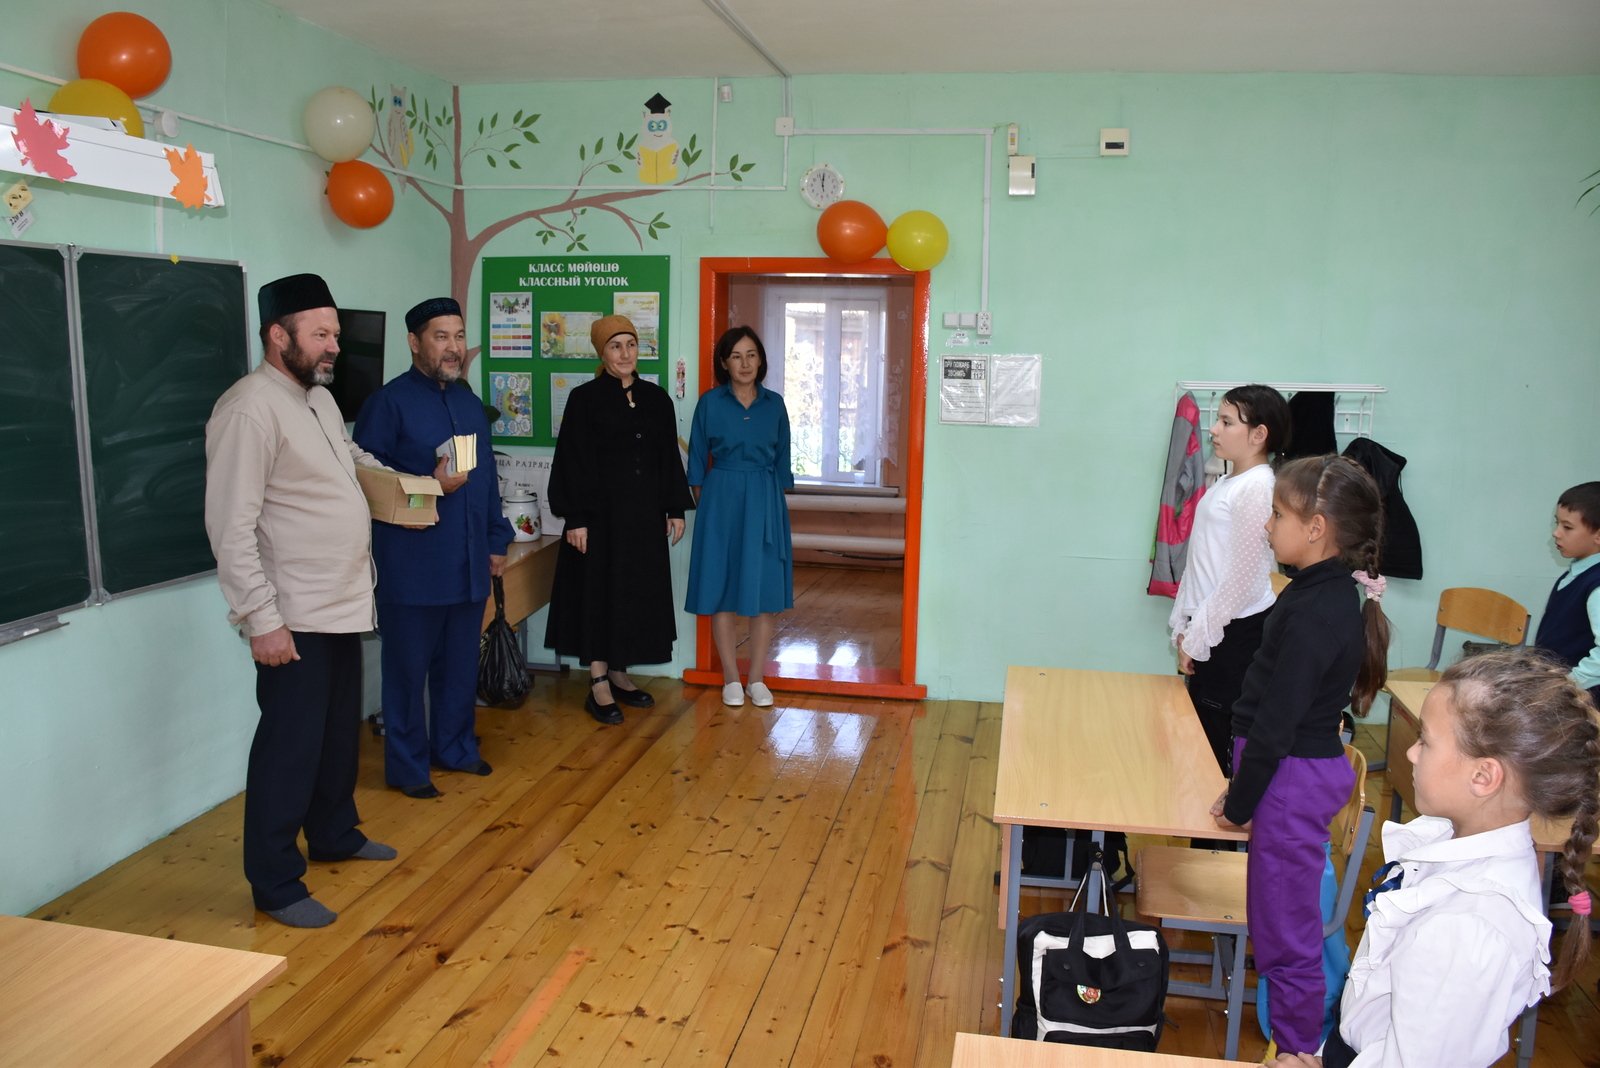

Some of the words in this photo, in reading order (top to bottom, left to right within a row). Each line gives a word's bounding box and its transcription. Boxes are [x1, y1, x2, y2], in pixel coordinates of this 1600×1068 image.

[528, 263, 565, 273] КЛАСС
[567, 261, 620, 273] МӨЙӨШӨ
[518, 275, 581, 287] КЛАССНЫЙ
[584, 276, 629, 287] УГОЛОК
